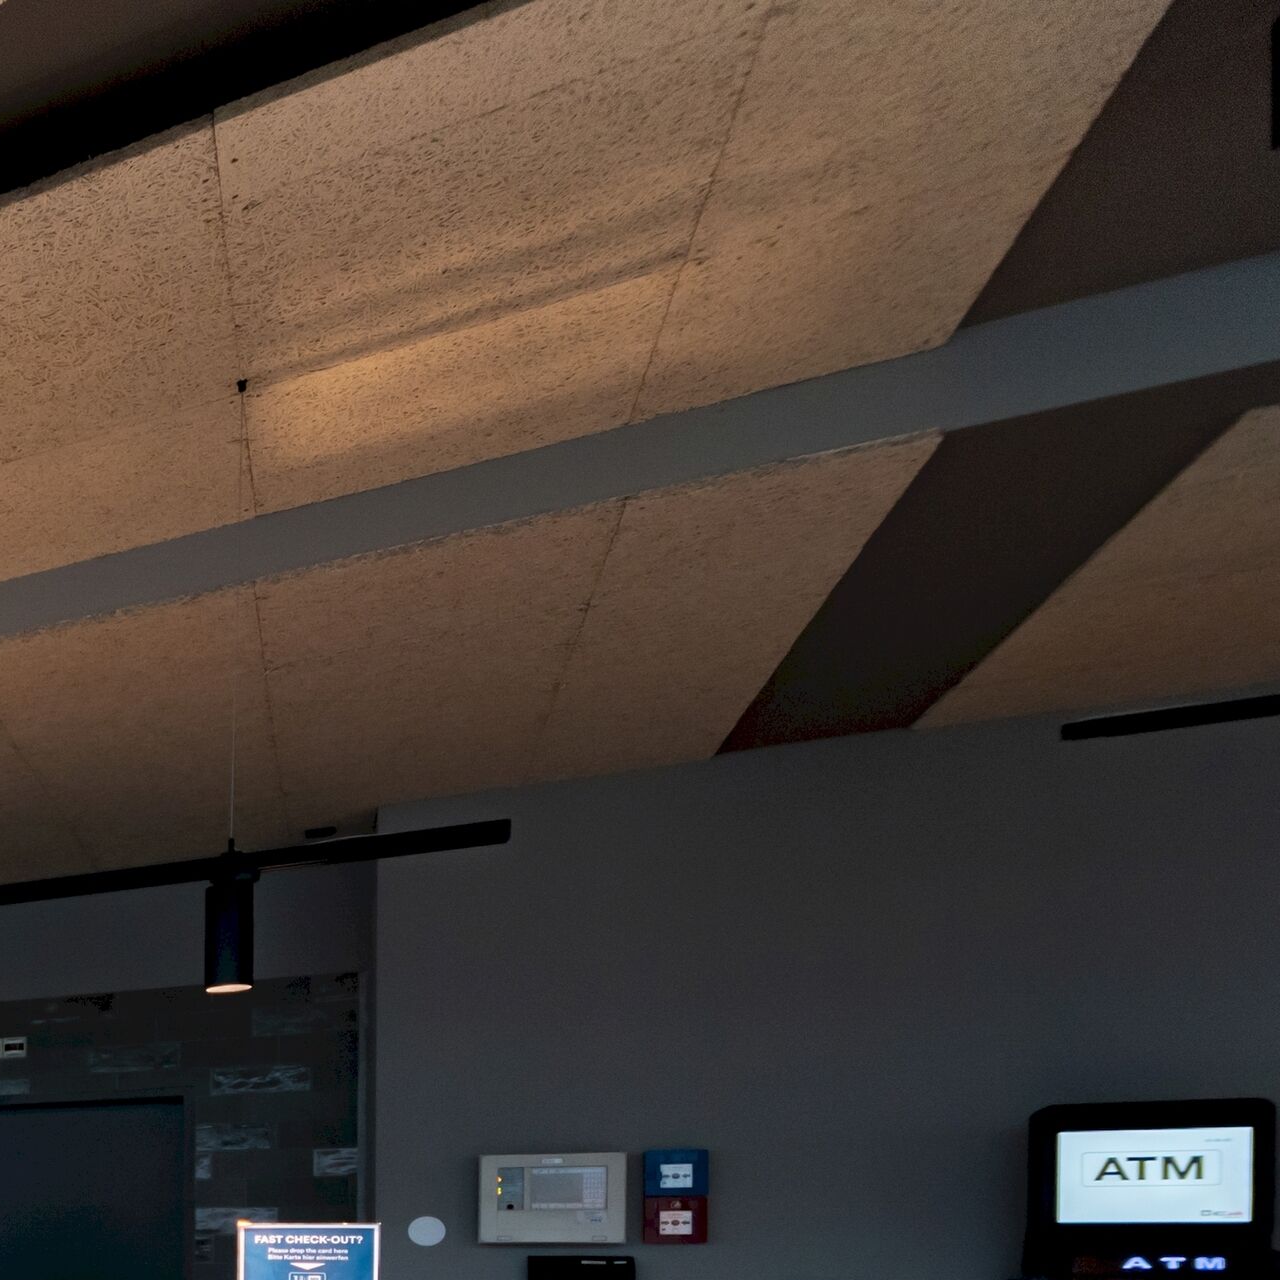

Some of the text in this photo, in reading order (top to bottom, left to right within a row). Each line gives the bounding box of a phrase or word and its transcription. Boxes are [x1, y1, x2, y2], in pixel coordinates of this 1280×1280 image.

[1094, 1155, 1205, 1181] ATM
[254, 1235, 364, 1245] FAST CHECK-OUT?
[1122, 1256, 1227, 1270] ATM
